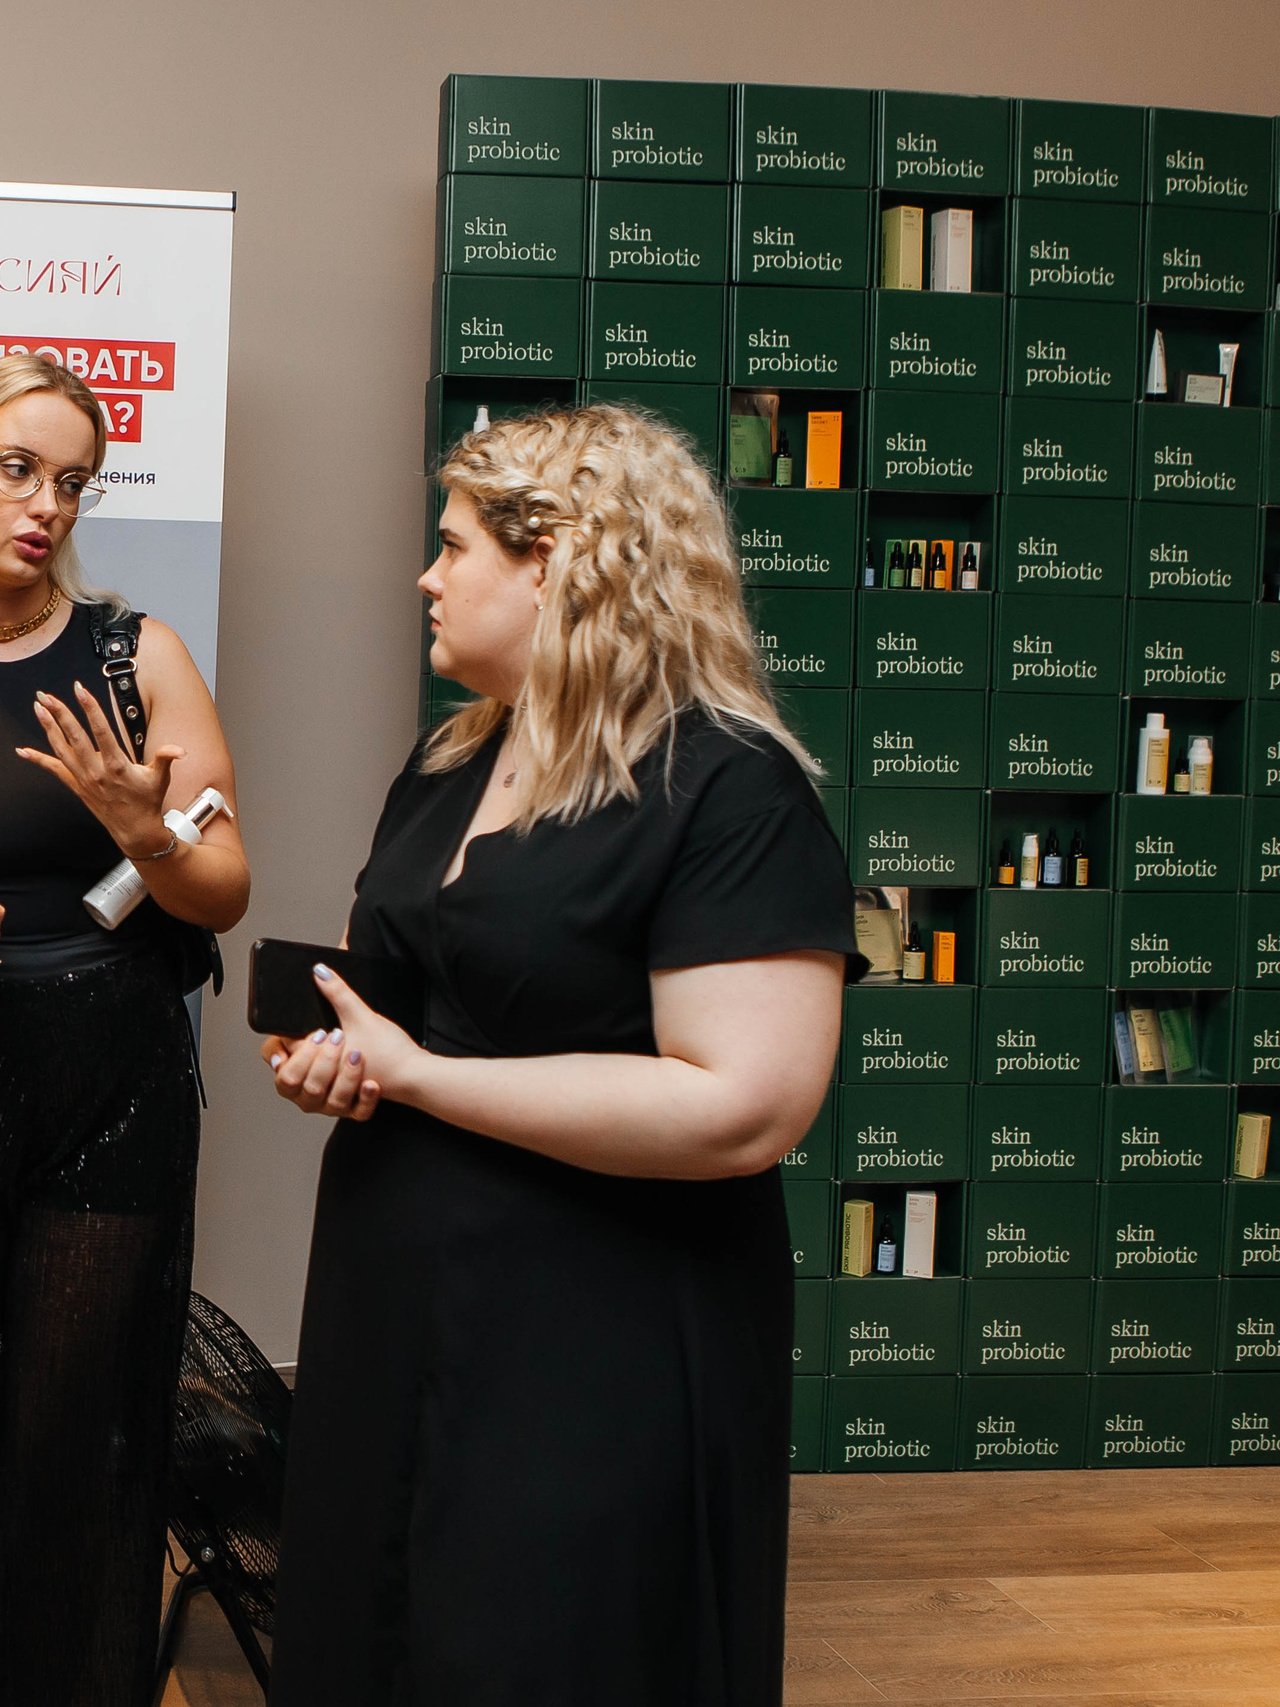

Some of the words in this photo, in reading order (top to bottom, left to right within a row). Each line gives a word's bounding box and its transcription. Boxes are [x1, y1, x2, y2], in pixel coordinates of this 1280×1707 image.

[468, 116, 511, 136] skin
[612, 121, 654, 141] skin
[757, 125, 798, 145] skin
[467, 140, 560, 163] probiotic
[897, 132, 937, 153] skin
[1034, 141, 1073, 161] skin
[612, 145, 703, 168] probiotic
[756, 149, 845, 172] probiotic
[896, 156, 983, 178] probiotic
[1166, 150, 1204, 171] skin
[1033, 165, 1118, 187] probiotic
[1166, 174, 1248, 196] probiotic
[464, 216, 508, 236] skin
[609, 222, 652, 242] skin
[753, 226, 795, 246] skin
[464, 241, 556, 263] probiotic
[609, 246, 700, 268] probiotic
[1030, 240, 1069, 260] skin
[1163, 247, 1201, 268] skin
[753, 250, 842, 272] probiotic
[1029, 264, 1114, 286] probiotic
[1162, 272, 1244, 294] probiotic
[461, 317, 504, 336] skin
[605, 323, 648, 343] skin
[749, 328, 790, 348] skin
[890, 331, 931, 351] skin
[460, 341, 553, 363] probiotic
[605, 347, 696, 369] probiotic
[1027, 340, 1066, 360] skin
[748, 352, 837, 375] probiotic
[889, 356, 976, 378] probiotic
[1026, 364, 1111, 386] probiotic
[886, 432, 927, 452] skin
[1023, 438, 1063, 458] skin
[1154, 446, 1193, 466] skin
[885, 456, 972, 479] probiotic
[1022, 462, 1107, 484] probiotic
[1154, 470, 1236, 491] probiotic
[741, 529, 783, 548] skin
[1018, 536, 1058, 556] skin
[740, 552, 830, 575] probiotic
[1150, 543, 1188, 563] skin
[1017, 560, 1102, 582] probiotic
[1149, 567, 1231, 589] probiotic
[877, 632, 918, 651] skin
[1013, 635, 1053, 654] skin
[1145, 641, 1183, 660] skin
[876, 655, 963, 678] probiotic
[1012, 658, 1097, 680] probiotic
[1144, 664, 1226, 686] probiotic
[873, 730, 914, 749] skin
[1009, 733, 1048, 752] skin
[872, 754, 959, 776] probiotic
[1008, 757, 1093, 779] probiotic
[869, 830, 909, 848] skin
[1136, 836, 1174, 854] skin
[868, 853, 955, 875] probiotic
[1135, 858, 1217, 881] probiotic
[1000, 931, 1040, 949] skin
[1131, 933, 1169, 951] skin
[1000, 954, 1084, 976] probiotic
[1130, 955, 1212, 978] probiotic
[863, 1028, 903, 1046] skin
[997, 1029, 1036, 1047] skin
[862, 1051, 948, 1074] probiotic
[996, 1052, 1080, 1074] probiotic
[857, 1126, 898, 1144] skin
[992, 1126, 1031, 1144] skin
[1122, 1126, 1160, 1144] skin
[857, 1148, 943, 1172] probiotic
[991, 1149, 1075, 1172] probiotic
[1120, 1149, 1202, 1171] probiotic
[987, 1223, 1026, 1241] skin
[1117, 1224, 1155, 1242] skin
[985, 1245, 1070, 1268] probiotic
[1115, 1246, 1197, 1268] probiotic
[850, 1321, 890, 1339] skin
[982, 1320, 1022, 1337] skin
[1111, 1319, 1149, 1337] skin
[1237, 1318, 1275, 1335] skin
[849, 1343, 935, 1366] probiotic
[981, 1342, 1065, 1364] probiotic
[1109, 1341, 1192, 1363] probiotic
[846, 1417, 885, 1435] skin
[977, 1416, 1015, 1433] skin
[1105, 1414, 1143, 1431] skin
[1232, 1412, 1269, 1429] skin
[844, 1440, 930, 1462] probiotic
[975, 1438, 1058, 1460] probiotic
[1103, 1436, 1185, 1458] probiotic
